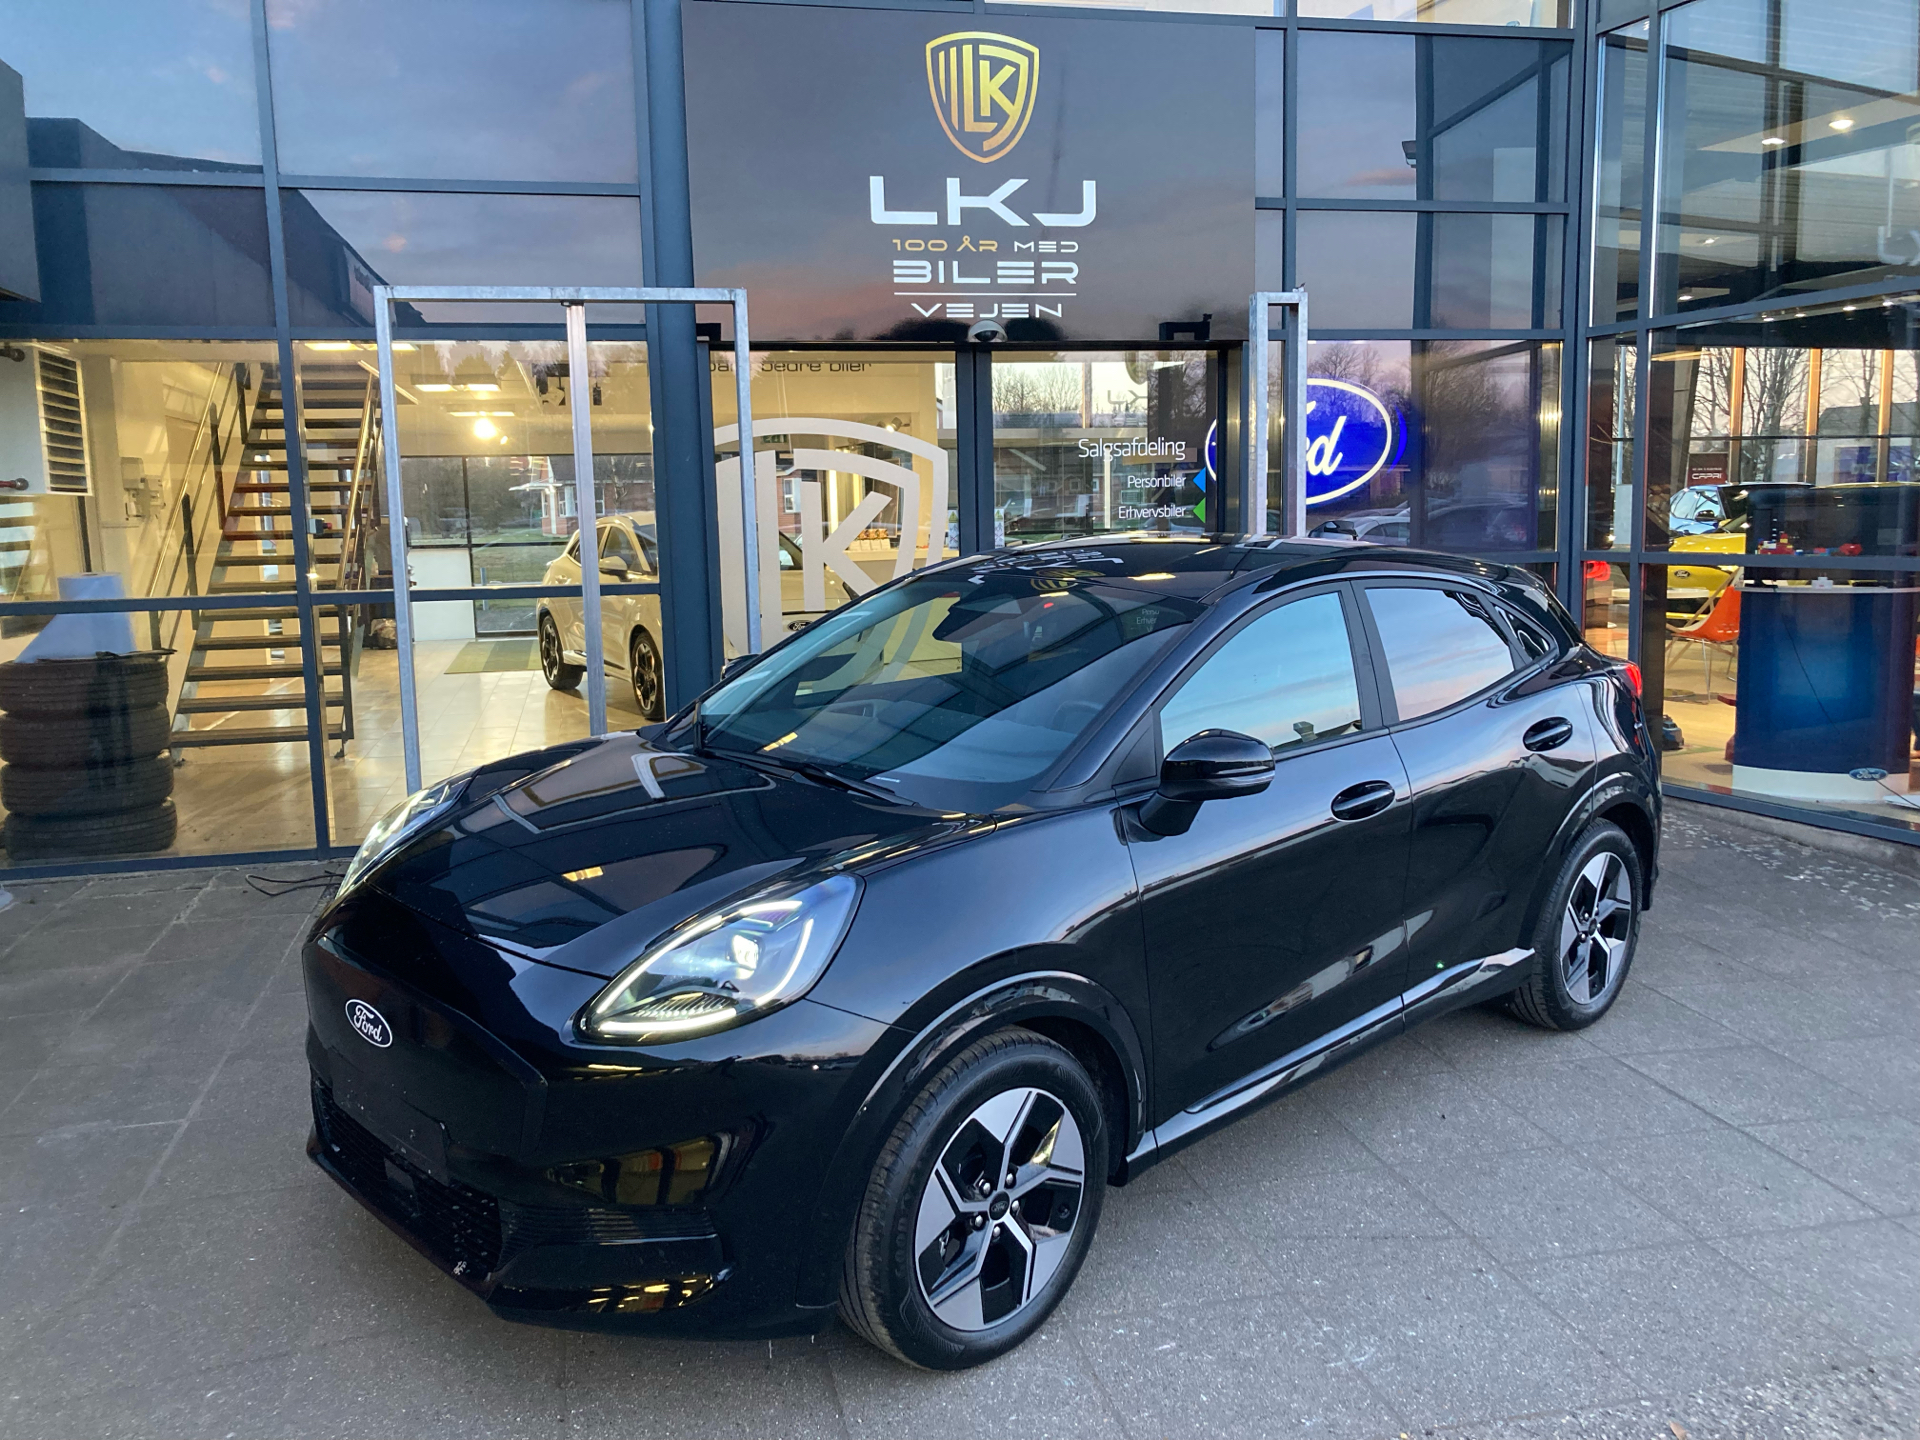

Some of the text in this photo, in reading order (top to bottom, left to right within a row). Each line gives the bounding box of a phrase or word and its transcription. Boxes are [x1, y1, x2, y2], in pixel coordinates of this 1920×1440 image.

[869, 175, 1097, 227] LKJ
[892, 235, 1079, 253] 100 ÅR MED
[893, 260, 1079, 284] BILER
[911, 302, 1062, 318] VEJEN
[1078, 437, 1186, 462] Salgsafdeling
[1127, 474, 1187, 488] Personbiler
[1118, 504, 1187, 519] Erhvervsbiler
[353, 1004, 382, 1042] Ford
